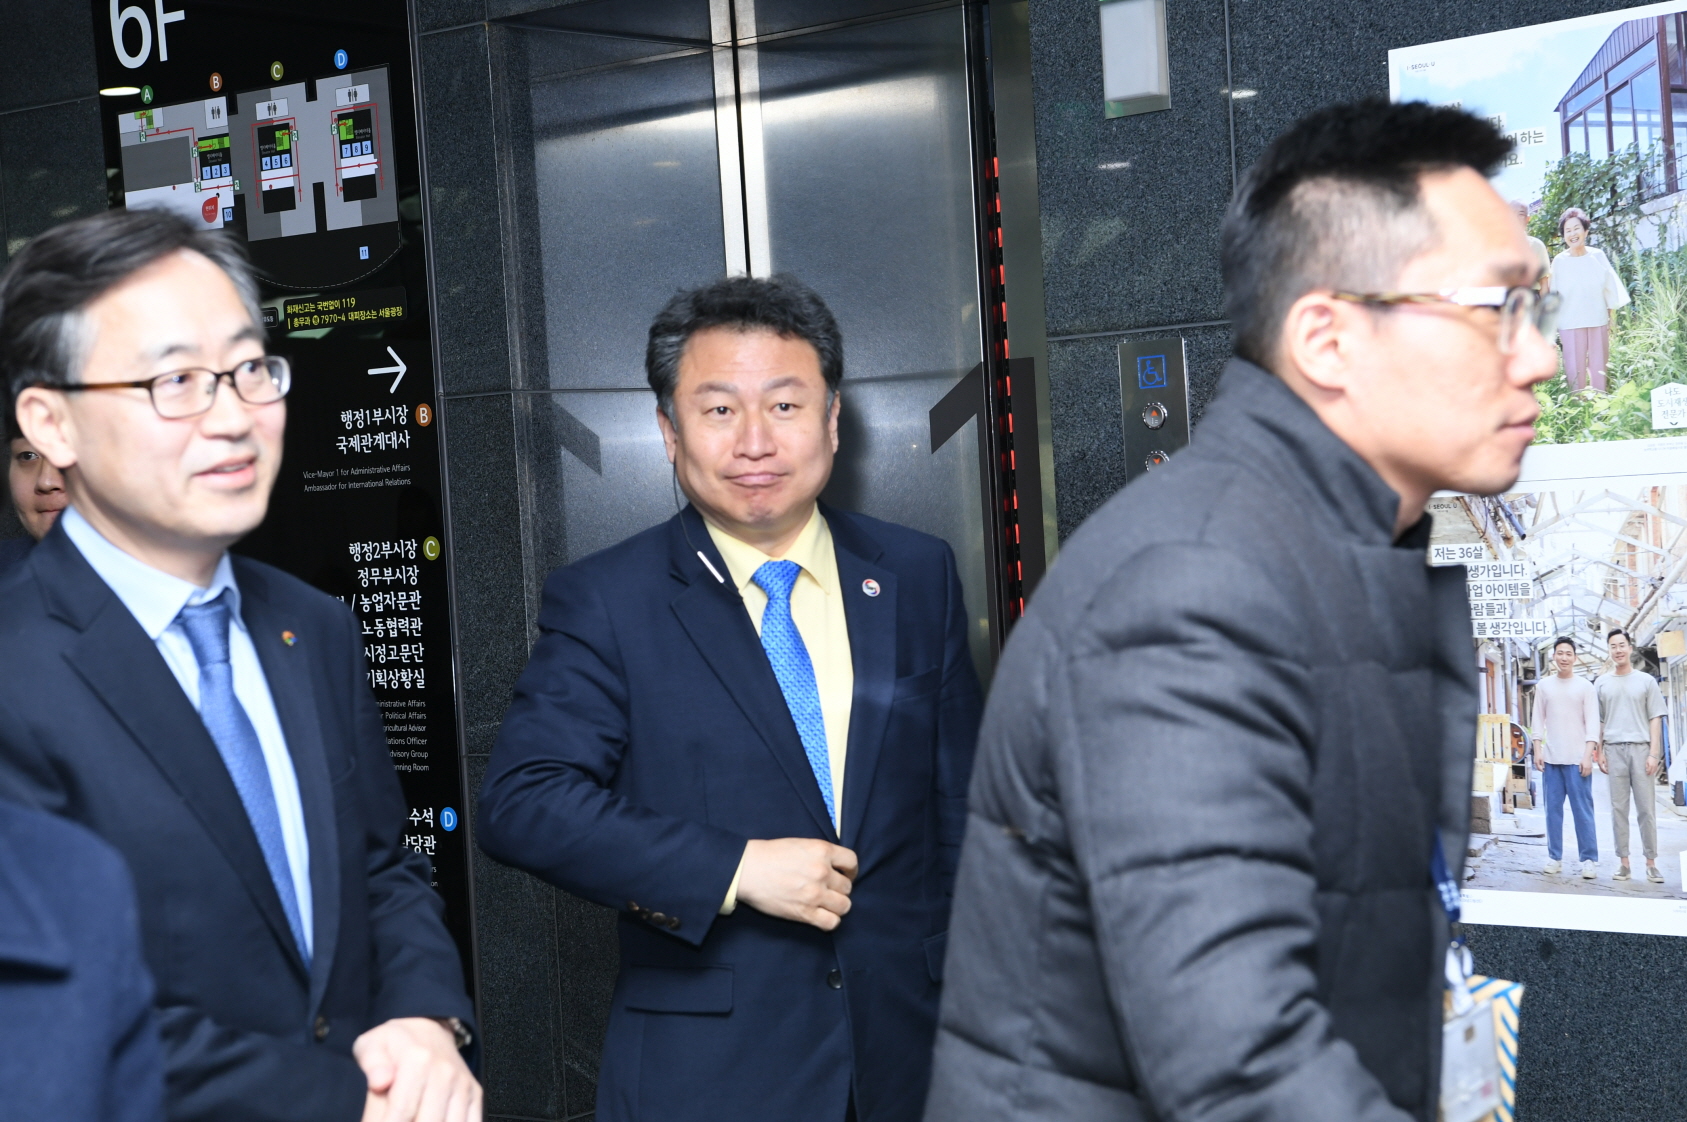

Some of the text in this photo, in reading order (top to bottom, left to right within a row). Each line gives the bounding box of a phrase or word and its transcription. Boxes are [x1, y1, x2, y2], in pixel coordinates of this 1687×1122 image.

[110, 0, 185, 69] 6F
[337, 53, 345, 66] D
[273, 64, 281, 78] C
[212, 75, 220, 89] B
[143, 89, 151, 101] A
[1520, 130, 1544, 145] 하는
[342, 297, 356, 308] 119
[321, 314, 346, 324] 7970~4
[347, 310, 378, 321] 대피장소는
[378, 306, 403, 317] 서울광장
[340, 404, 429, 430] 행정1부시장 B
[335, 429, 411, 455] 국제관계대사
[302, 463, 411, 479] Vice-Mayor 1 for Administrative Affairs
[303, 478, 412, 492] Ambassador for International Relations
[348, 538, 436, 563] 행정2부시장 C
[1434, 545, 1484, 561] 저는 36살
[357, 564, 420, 588] 정무부시장
[1467, 563, 1528, 578] 생가입니다.
[1485, 582, 1531, 597] 아이템을
[359, 589, 422, 613] 농업자문관
[1471, 602, 1507, 617] 람들과
[361, 616, 424, 638] 노동협력관
[1476, 620, 1550, 636] 볼 생각입니다.
[363, 642, 425, 664] 시정고문단
[366, 667, 426, 690] 기획상황실
[407, 700, 427, 708] Affairs
[385, 711, 407, 720] Political
[408, 711, 427, 720] Affairs
[383, 724, 427, 733] gricultural Advisor
[386, 736, 428, 745] lations Officer
[389, 749, 429, 760] dvisory Group
[412, 763, 430, 771] Room
[406, 807, 454, 829] 수석 D
